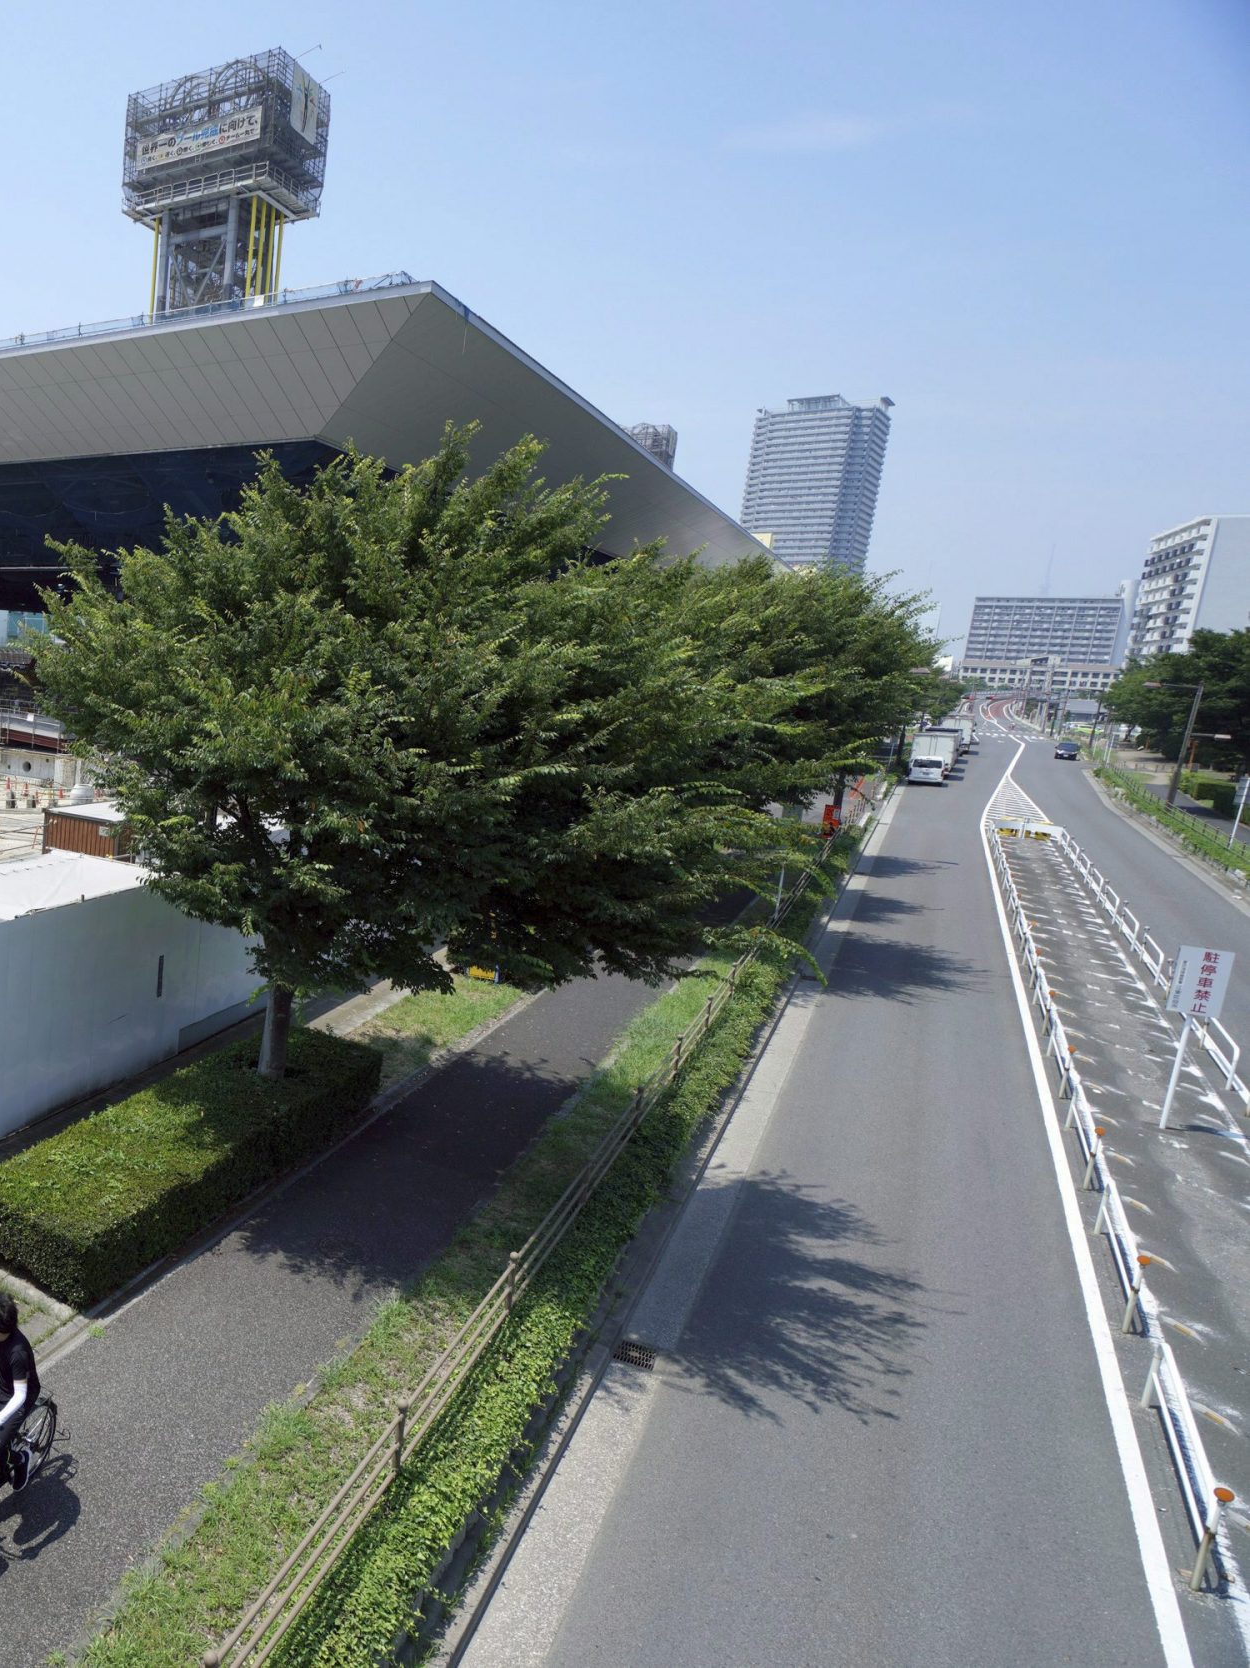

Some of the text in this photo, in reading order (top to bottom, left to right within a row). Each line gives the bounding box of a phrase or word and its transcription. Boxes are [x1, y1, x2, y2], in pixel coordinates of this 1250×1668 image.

[1191, 952, 1220, 1013] 駐停車禁止
